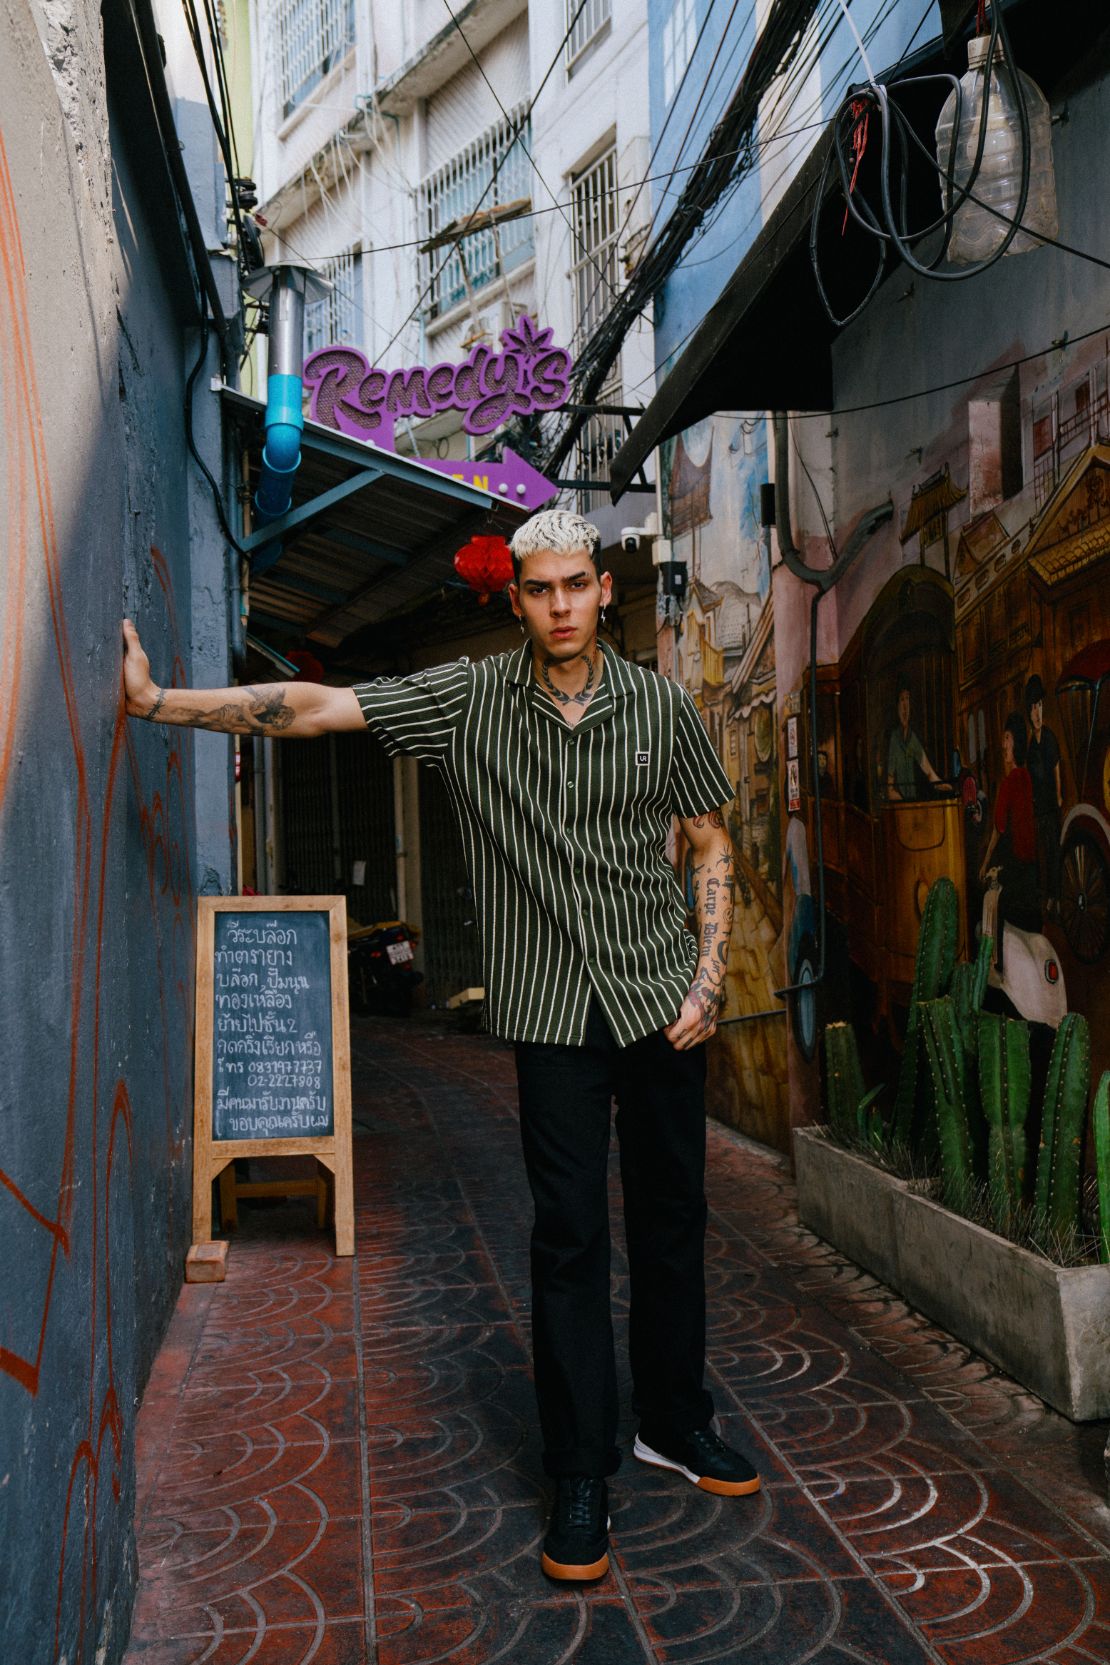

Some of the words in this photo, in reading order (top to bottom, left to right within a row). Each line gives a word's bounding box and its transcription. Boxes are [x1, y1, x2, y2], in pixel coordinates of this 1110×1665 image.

[214, 945, 293, 966] ทำตรายาง
[215, 989, 292, 1009] ทองเหลือง
